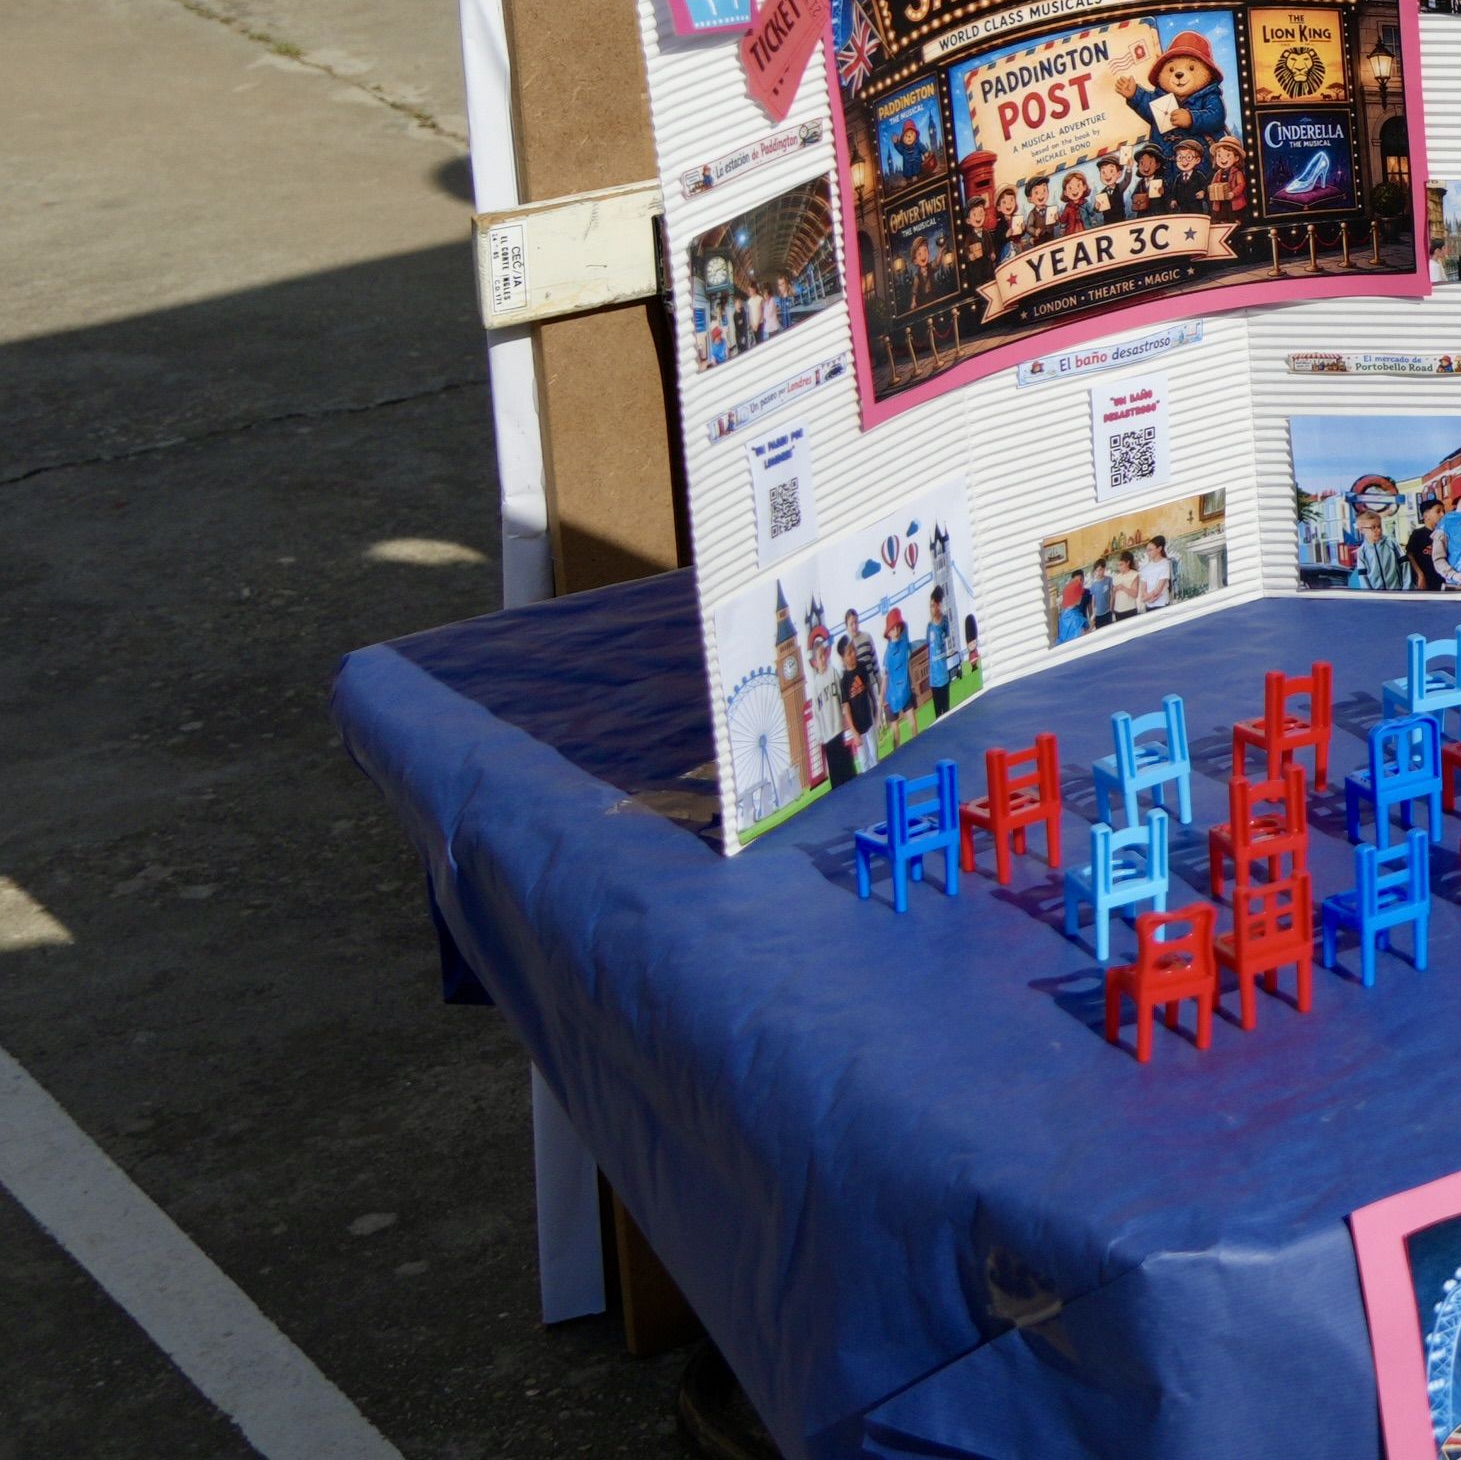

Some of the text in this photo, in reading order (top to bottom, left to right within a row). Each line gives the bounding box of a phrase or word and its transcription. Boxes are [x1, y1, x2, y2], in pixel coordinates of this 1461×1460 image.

[938, 21, 982, 53] WORLD
[983, 9, 1026, 32] CLASS
[1287, 14, 1306, 24] THE
[1261, 24, 1333, 44] LION KING
[979, 39, 1110, 105] PADDINGTON
[877, 82, 937, 121] PADDINGTON
[889, 103, 925, 126] THE MUSICAL
[996, 72, 1095, 142] POST
[1012, 112, 1108, 154] A MUSICAL ADVENTURE
[1031, 145, 1050, 158] based
[1061, 138, 1073, 147] the
[1074, 132, 1091, 142] book
[1092, 128, 1101, 138] by
[1263, 120, 1345, 147] CINDERELLA
[1288, 139, 1332, 149] THE MUSICAL
[751, 134, 799, 163] de Paddington
[1036, 140, 1092, 165] MICHAEL BOND
[889, 193, 947, 234] OLIVER TWIST
[912, 217, 937, 232] MUSICAL
[1025, 223, 1170, 283] YEAR 3C
[1033, 267, 1181, 319] LONDON THEATRE MAGIC
[1059, 334, 1172, 373] El baño desastroso
[1354, 362, 1434, 373] Portobello Road
[1362, 355, 1422, 364] El mercado de
[786, 376, 813, 394] Londres
